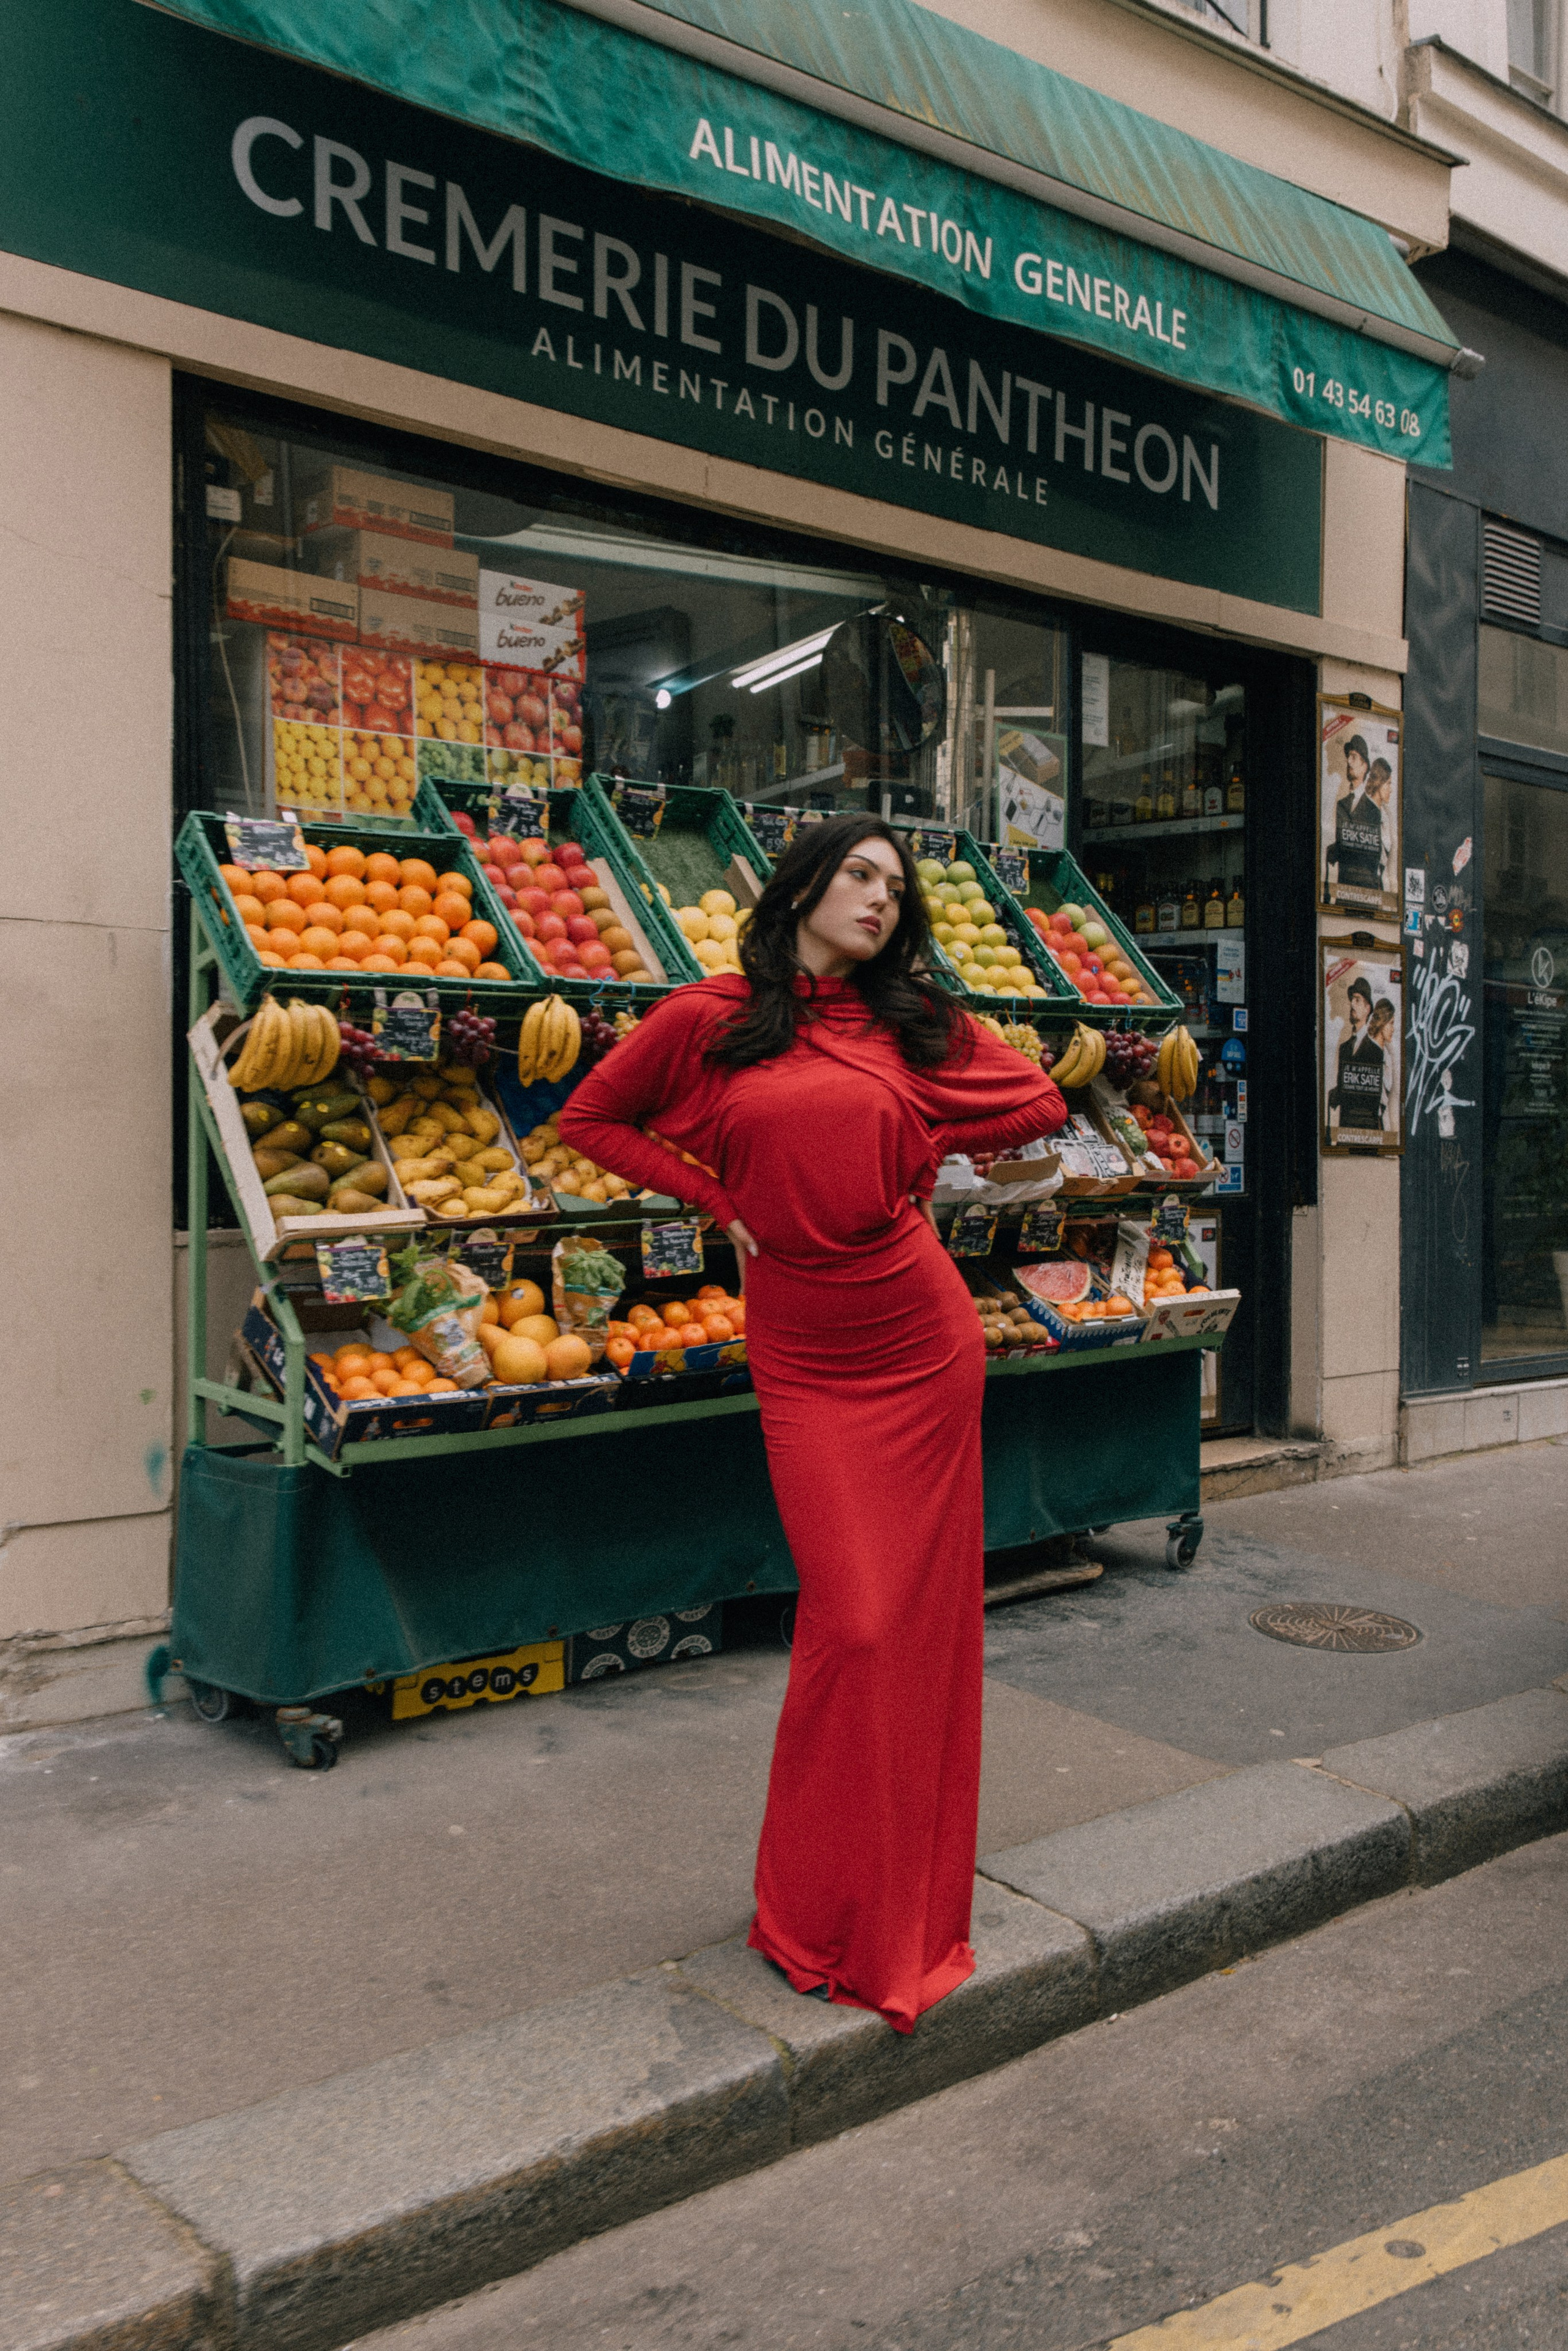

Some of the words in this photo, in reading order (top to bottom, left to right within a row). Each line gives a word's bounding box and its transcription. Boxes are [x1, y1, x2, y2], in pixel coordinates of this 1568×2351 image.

[688, 118, 993, 279] ALIMENTATION
[1014, 252, 1188, 351] GENERALE
[232, 116, 722, 354] CREMERIE
[746, 284, 853, 390] DU
[877, 329, 1219, 510] PANTHEON
[532, 327, 854, 448] ALIMENTATION
[875, 431, 1049, 506] GÉNÉRALE
[1293, 367, 1315, 398] 01
[1322, 378, 1345, 409] 43
[1348, 388, 1372, 419] 54
[1374, 399, 1396, 429] 63
[1400, 408, 1422, 438] 08
[495, 587, 546, 606] bueno
[496, 629, 546, 648] bueno
[1342, 829, 1359, 842] ERIK
[1359, 832, 1380, 847] SATIE
[1343, 1072, 1360, 1085] ERIK
[1360, 1074, 1380, 1087] SATIE
[429, 1669, 532, 1699] stems
